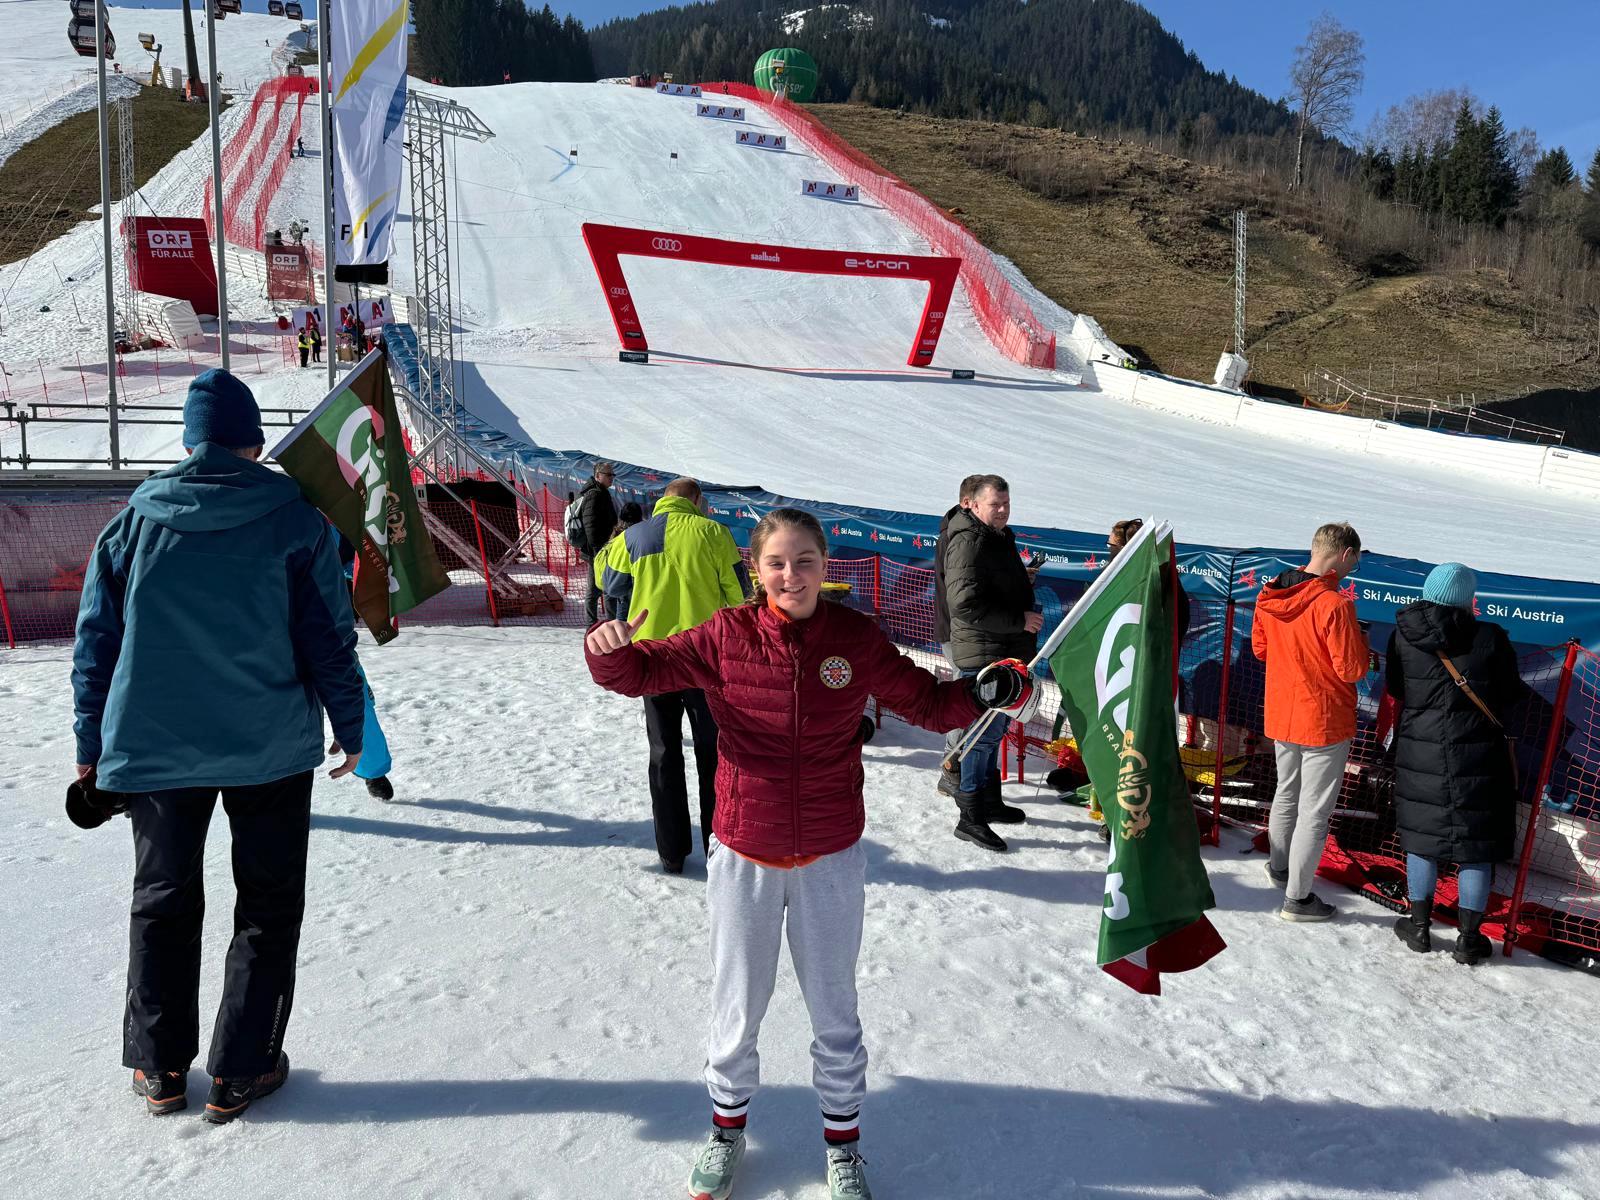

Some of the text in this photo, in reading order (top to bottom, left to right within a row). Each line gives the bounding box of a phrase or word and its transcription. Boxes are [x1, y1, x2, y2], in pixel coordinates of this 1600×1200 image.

[152, 233, 187, 244] ORF
[151, 249, 195, 259] FÜR ALLE
[751, 251, 780, 263] saalbach
[845, 258, 910, 270] e-tron
[372, 298, 385, 320] A1
[847, 528, 863, 537] Austria
[886, 534, 903, 543] Austria
[923, 539, 932, 547] Ski
[1044, 552, 1068, 564] Austria
[1176, 564, 1222, 579] Ski Austria
[1363, 588, 1421, 605] Ski Austri
[1486, 604, 1565, 624] Ski Austria
